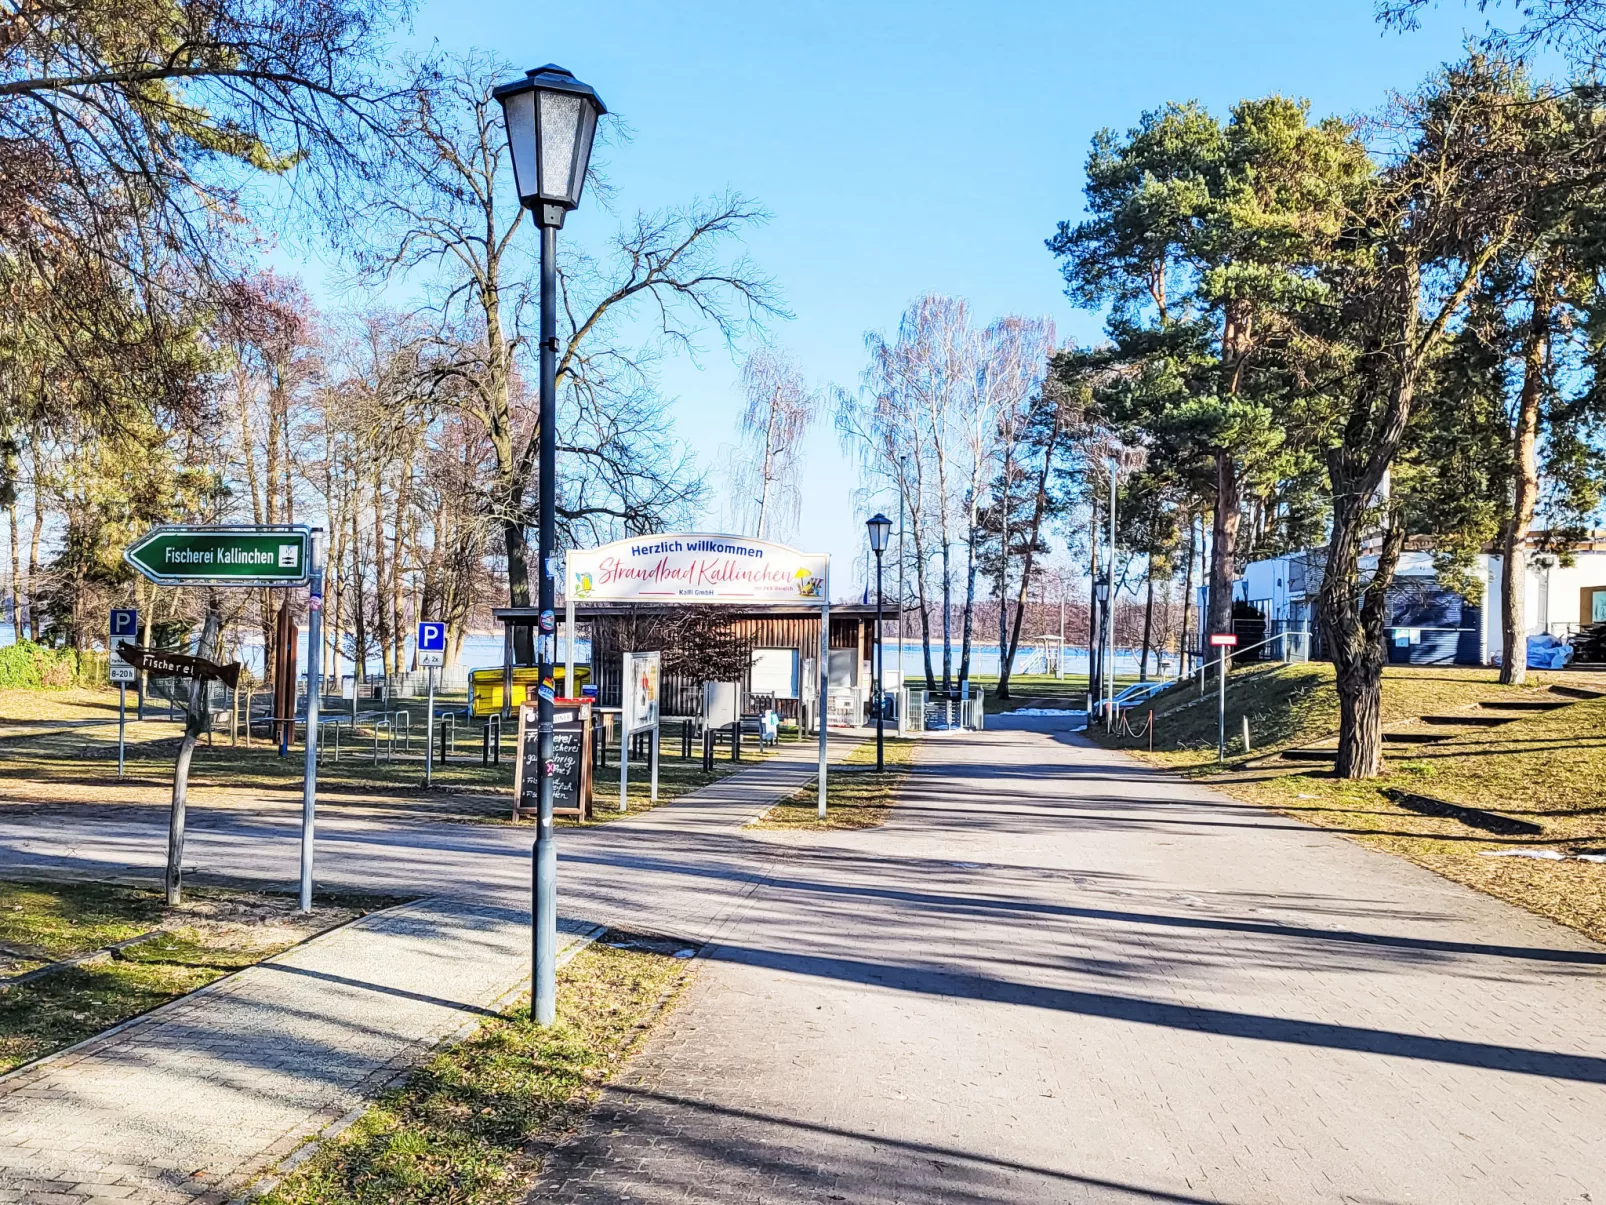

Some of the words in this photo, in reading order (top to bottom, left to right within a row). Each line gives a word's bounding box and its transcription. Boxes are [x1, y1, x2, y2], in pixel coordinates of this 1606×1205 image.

[165, 547, 214, 564] Fischerei
[217, 547, 274, 565] Kallinchen
[631, 541, 683, 557] Herzlich
[686, 541, 763, 558] willkommen
[599, 556, 697, 585] Strandbad
[697, 557, 794, 586] Kallinchen
[116, 612, 130, 632] P
[424, 625, 439, 647] P
[142, 654, 194, 675] Fischerei
